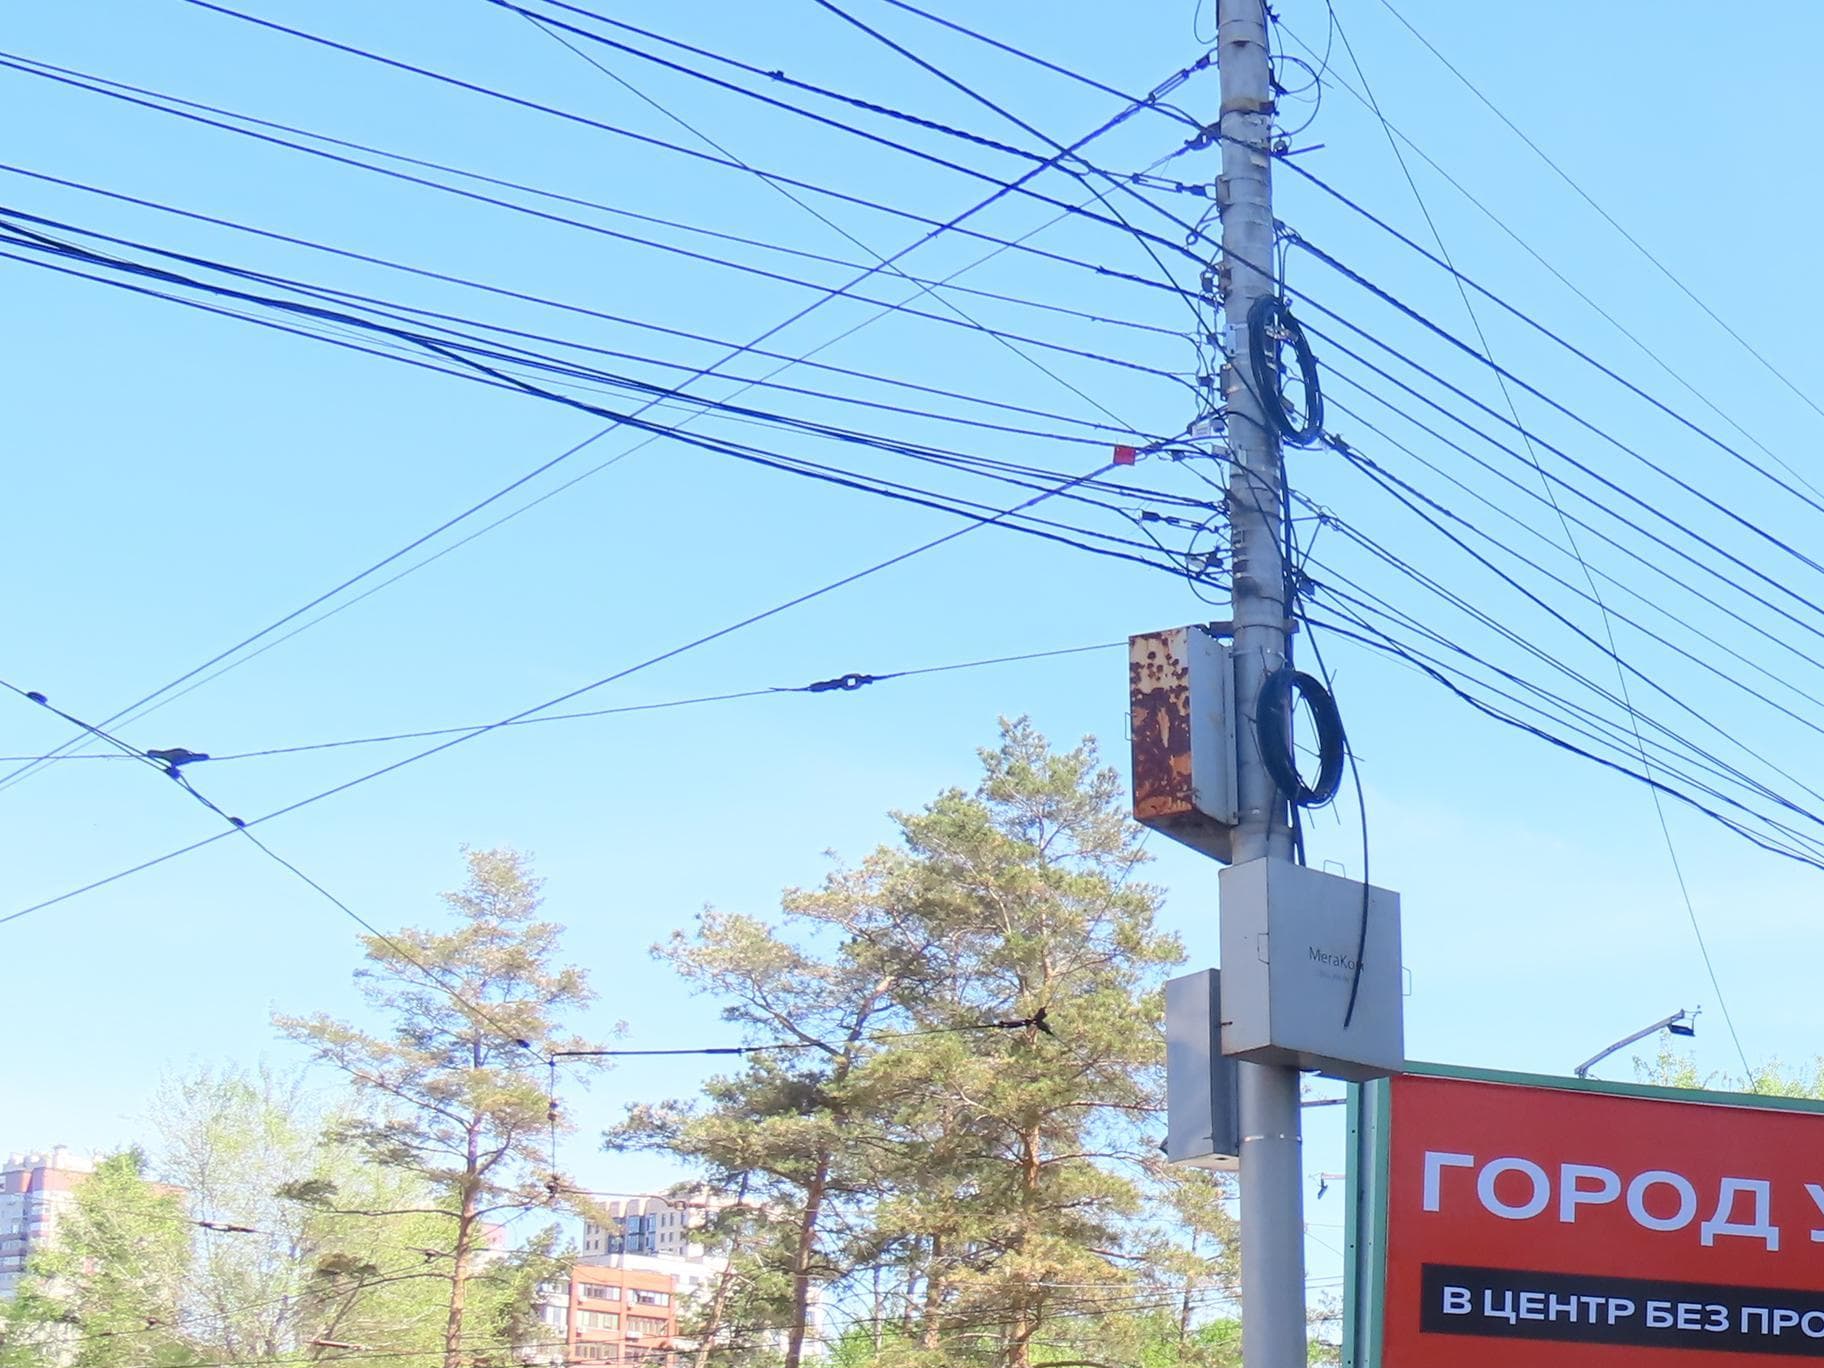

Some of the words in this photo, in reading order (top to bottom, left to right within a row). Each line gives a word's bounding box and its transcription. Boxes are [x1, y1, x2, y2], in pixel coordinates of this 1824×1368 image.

[1423, 1150, 1780, 1252] ГОРОД
[1442, 1286, 1473, 1315] В
[1483, 1288, 1636, 1326] ЦЕНТР
[1645, 1301, 1730, 1332] БЕЗ
